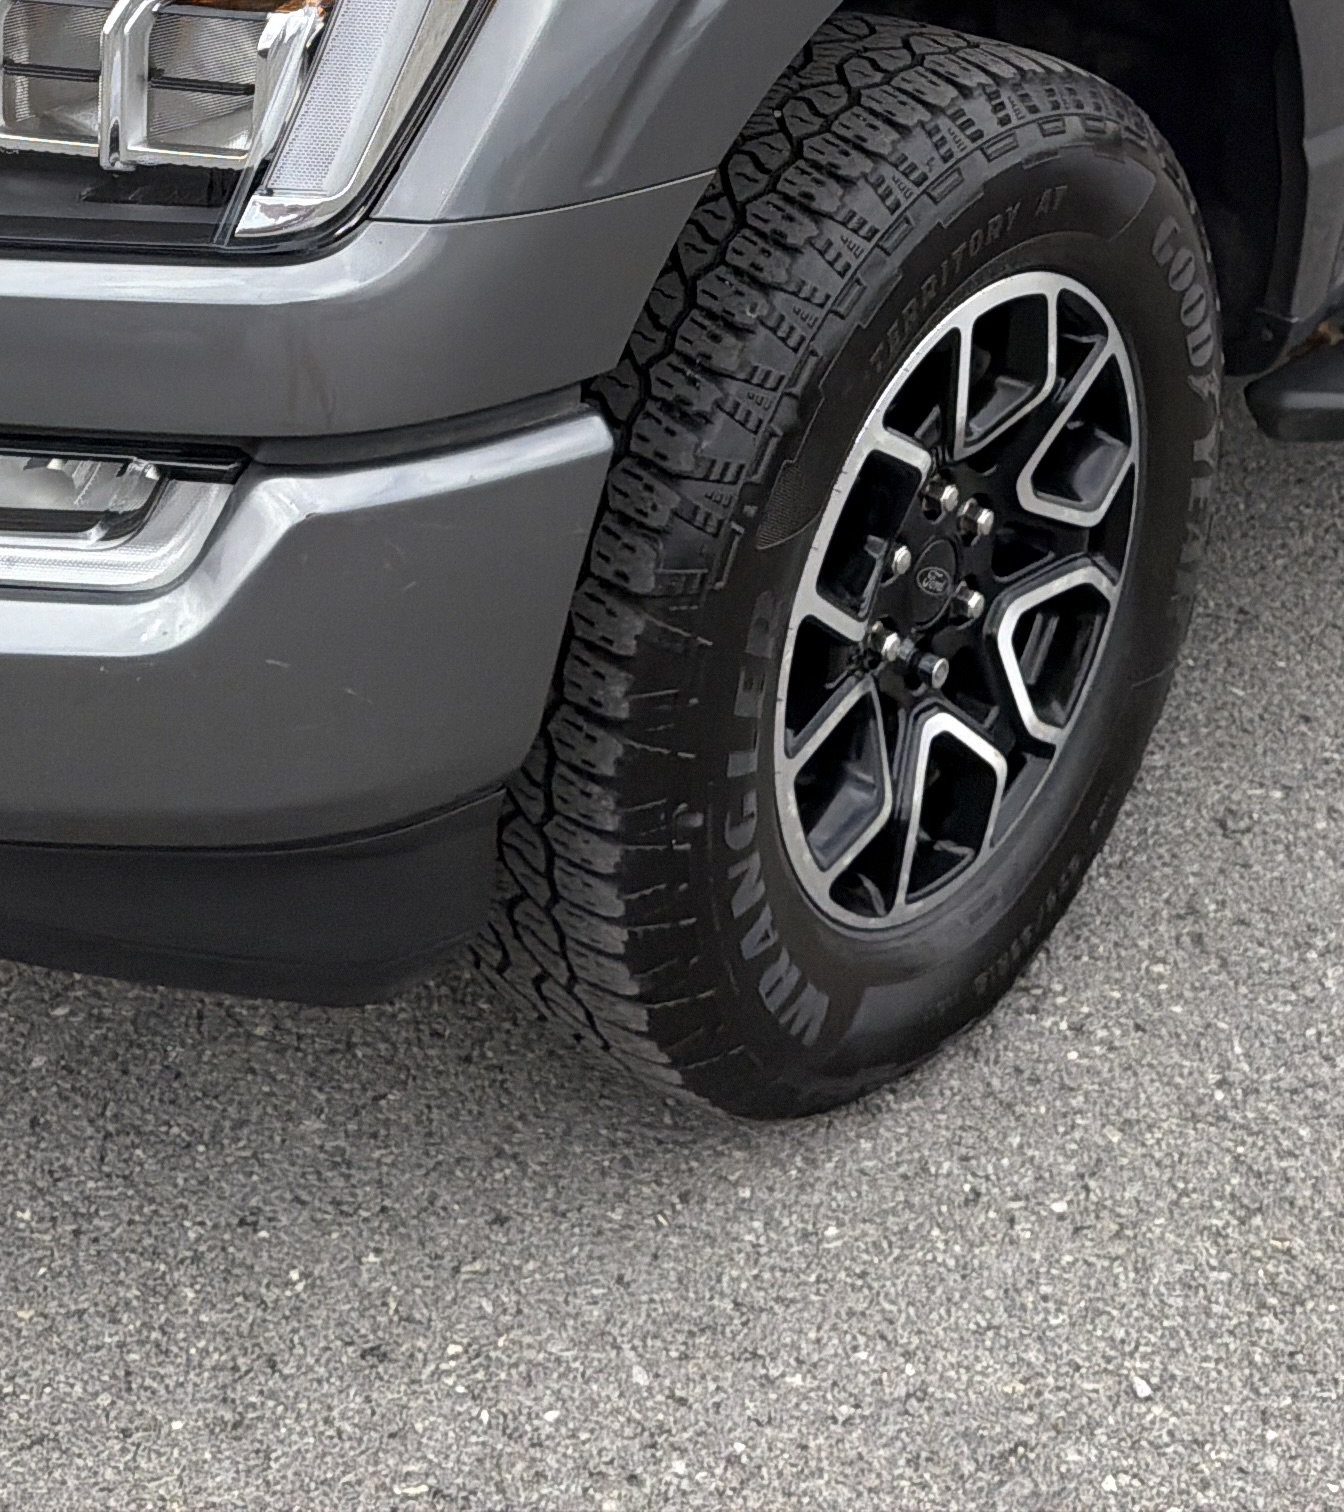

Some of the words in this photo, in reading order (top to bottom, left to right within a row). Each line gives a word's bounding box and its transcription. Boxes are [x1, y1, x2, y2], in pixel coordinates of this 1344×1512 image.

[869, 199, 1022, 373] TERRITORY
[1035, 185, 1068, 216] AT
[724, 589, 830, 1047] WRANGLER
